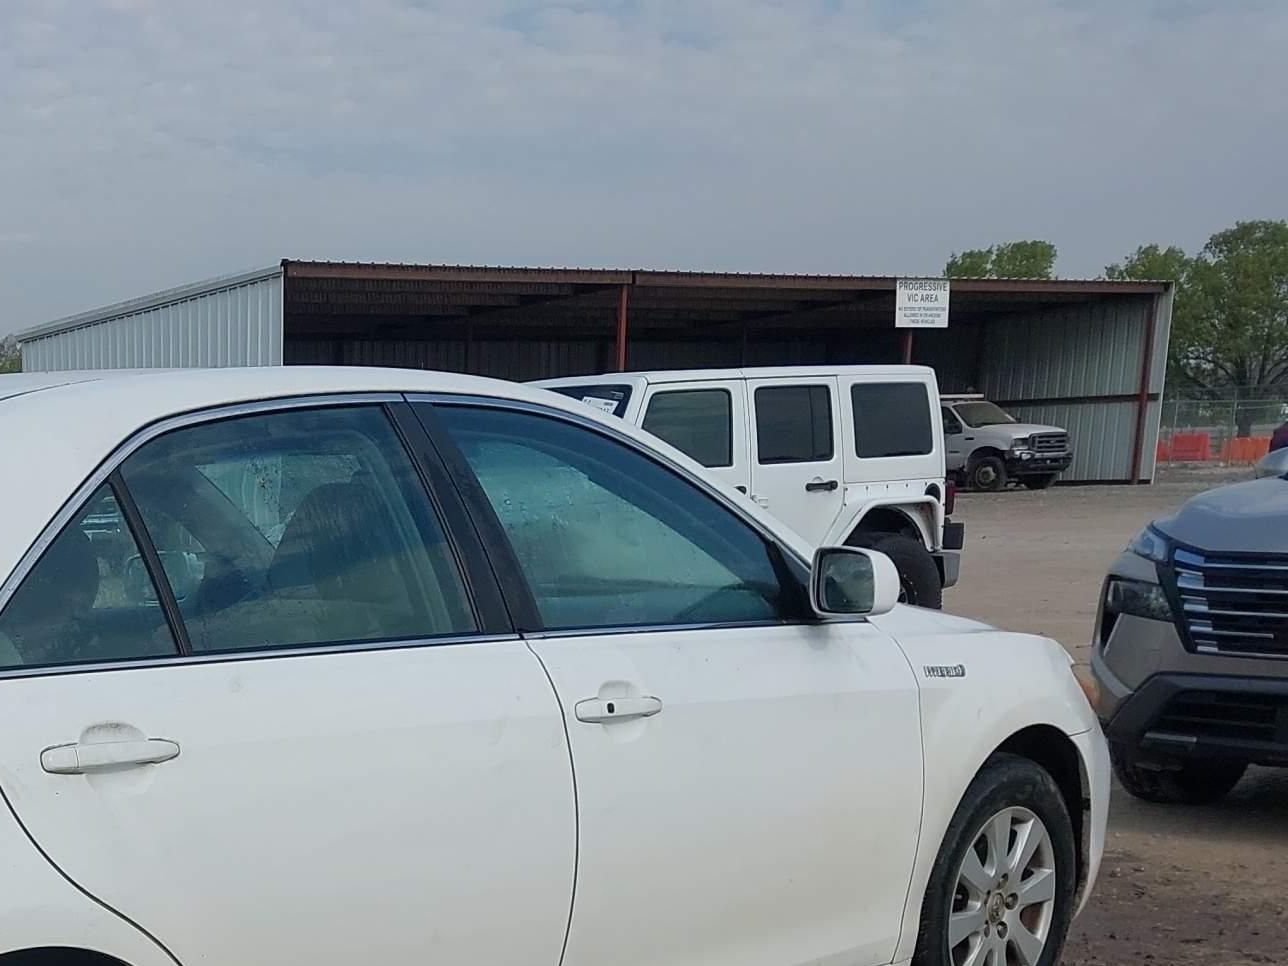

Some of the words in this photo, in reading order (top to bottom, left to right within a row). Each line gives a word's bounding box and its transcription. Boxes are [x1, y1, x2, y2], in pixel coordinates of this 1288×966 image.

[898, 281, 948, 292] PROGRESSIVE
[907, 293, 919, 303] VIC
[920, 293, 939, 303] AREA
